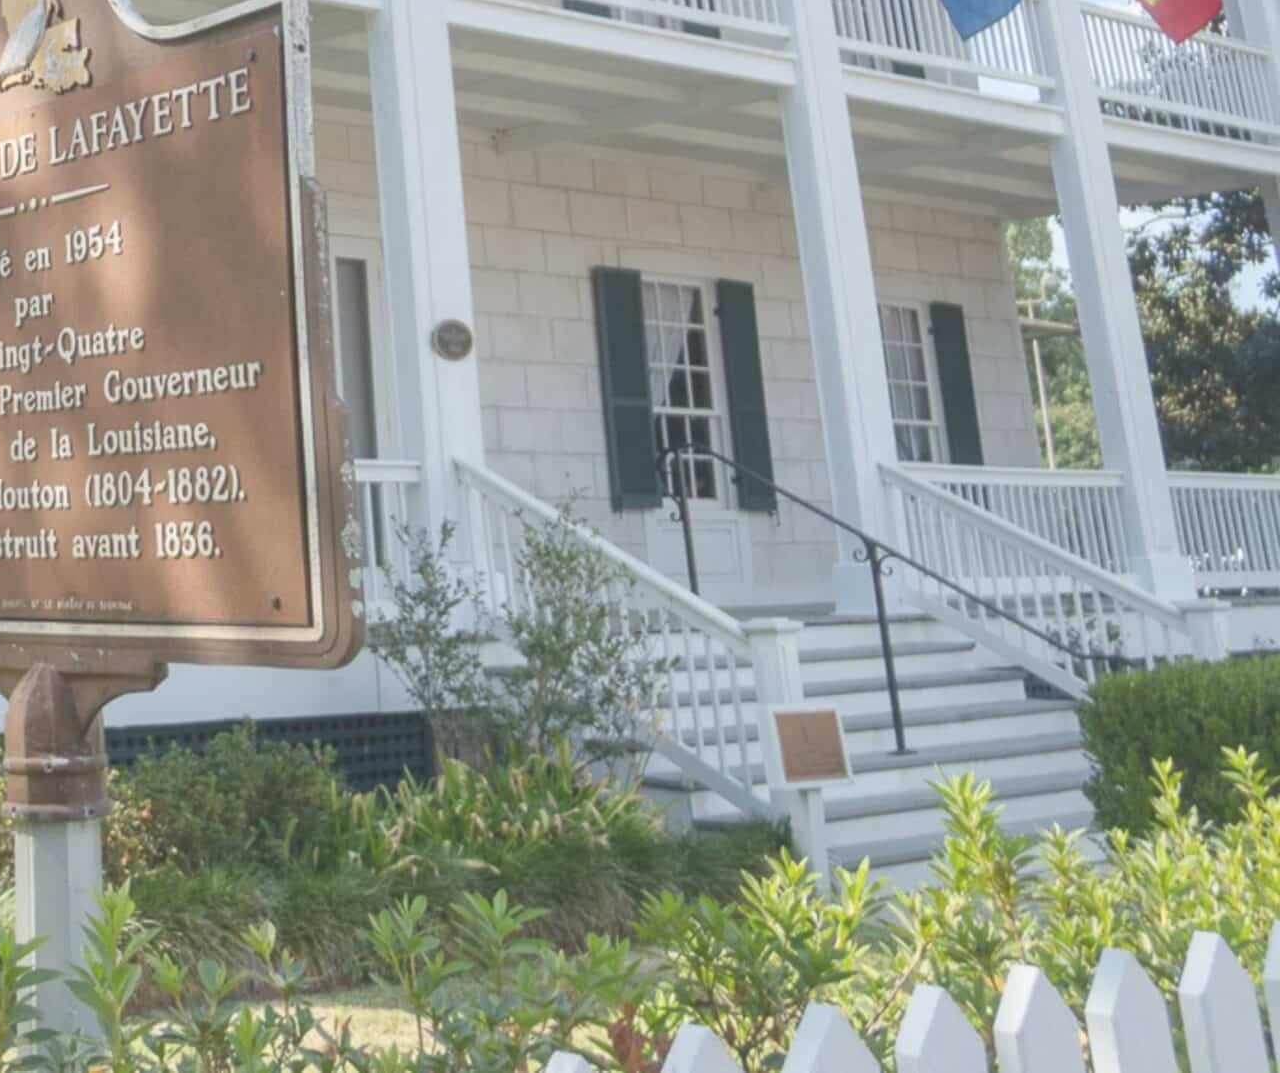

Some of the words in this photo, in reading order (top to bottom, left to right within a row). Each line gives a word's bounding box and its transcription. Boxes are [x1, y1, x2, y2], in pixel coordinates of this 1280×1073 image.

[0, 133, 37, 179] DE
[49, 68, 251, 164] LAFAYETTE
[25, 246, 50, 271] en
[64, 220, 121, 263] 1954
[15, 293, 53, 326] par
[0, 381, 86, 415] Premier
[104, 361, 261, 402] Gouverneur
[11, 430, 36, 460] de
[51, 428, 72, 459] la
[88, 420, 216, 456] Louisiane,
[85, 465, 245, 507] (1804-1882).
[72, 525, 139, 557] avant
[154, 521, 220, 557] 1836.
